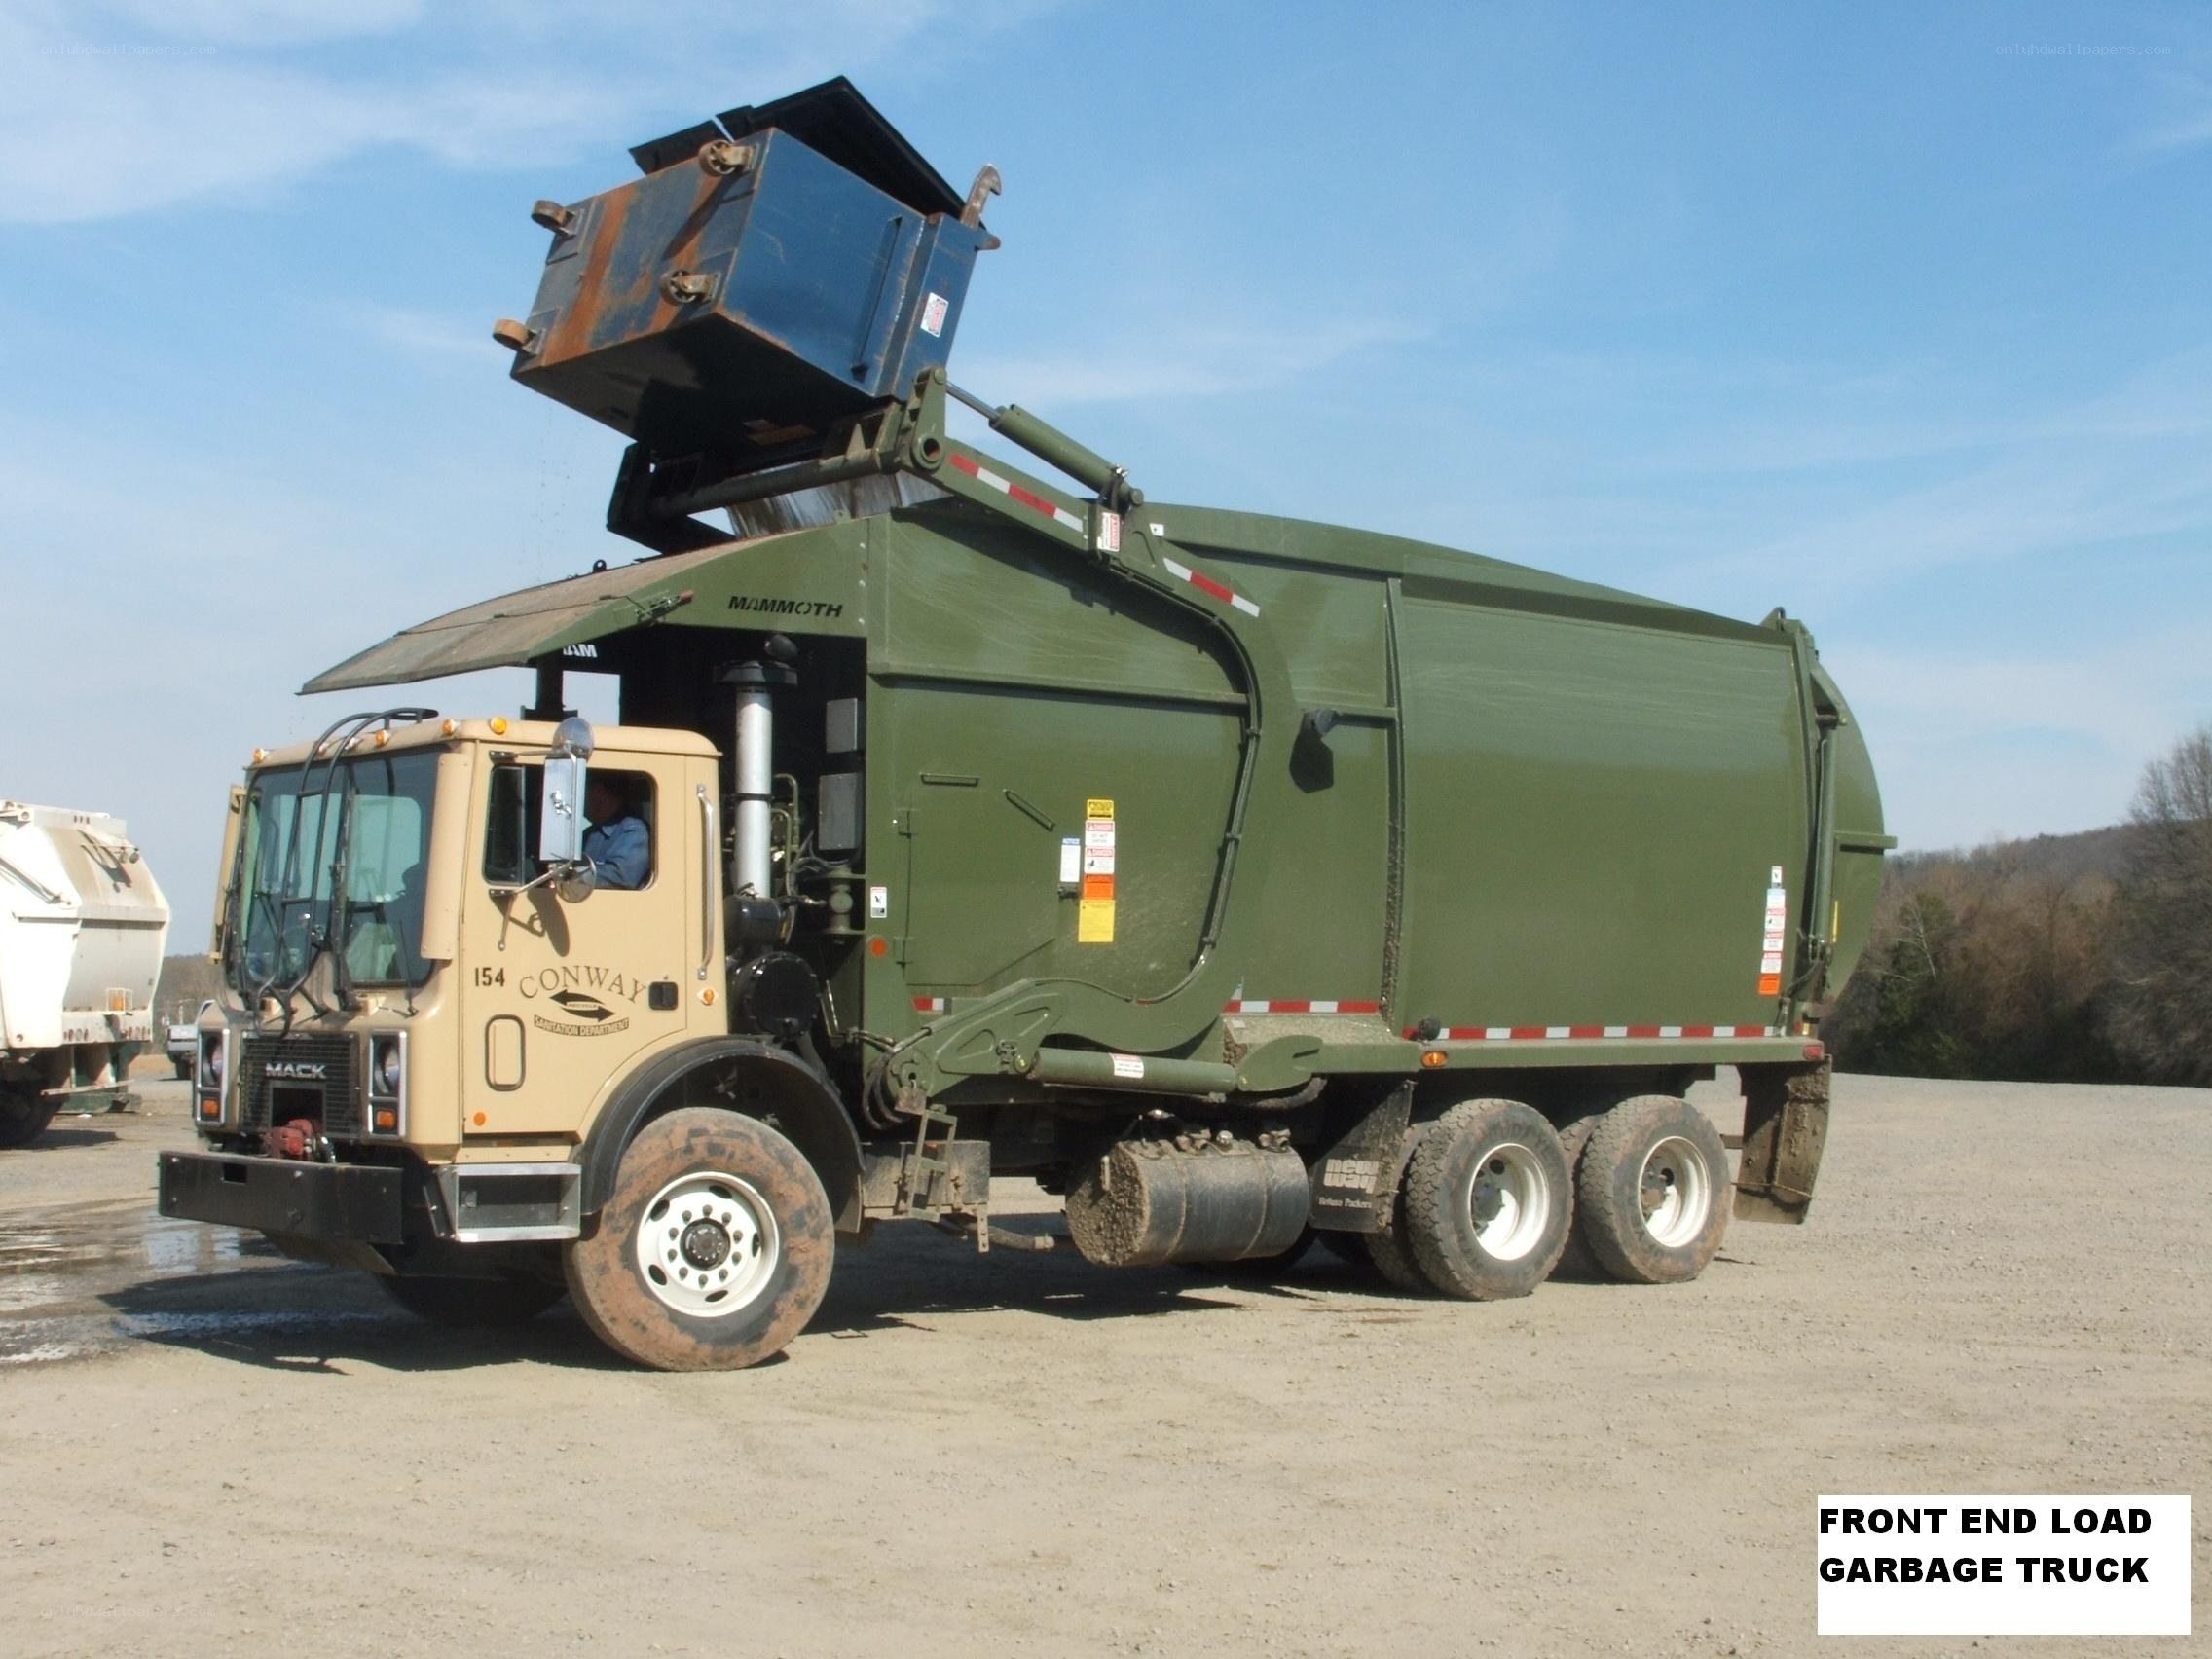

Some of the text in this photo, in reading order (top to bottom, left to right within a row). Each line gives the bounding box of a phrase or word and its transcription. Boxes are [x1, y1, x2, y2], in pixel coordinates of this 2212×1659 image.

[727, 596, 844, 618] MAMMOTH
[475, 967, 506, 987] 154
[519, 965, 647, 1004] CONWAY
[535, 1016, 630, 1036] SANITATION DEPARTMENT
[265, 1062, 327, 1080] MACK
